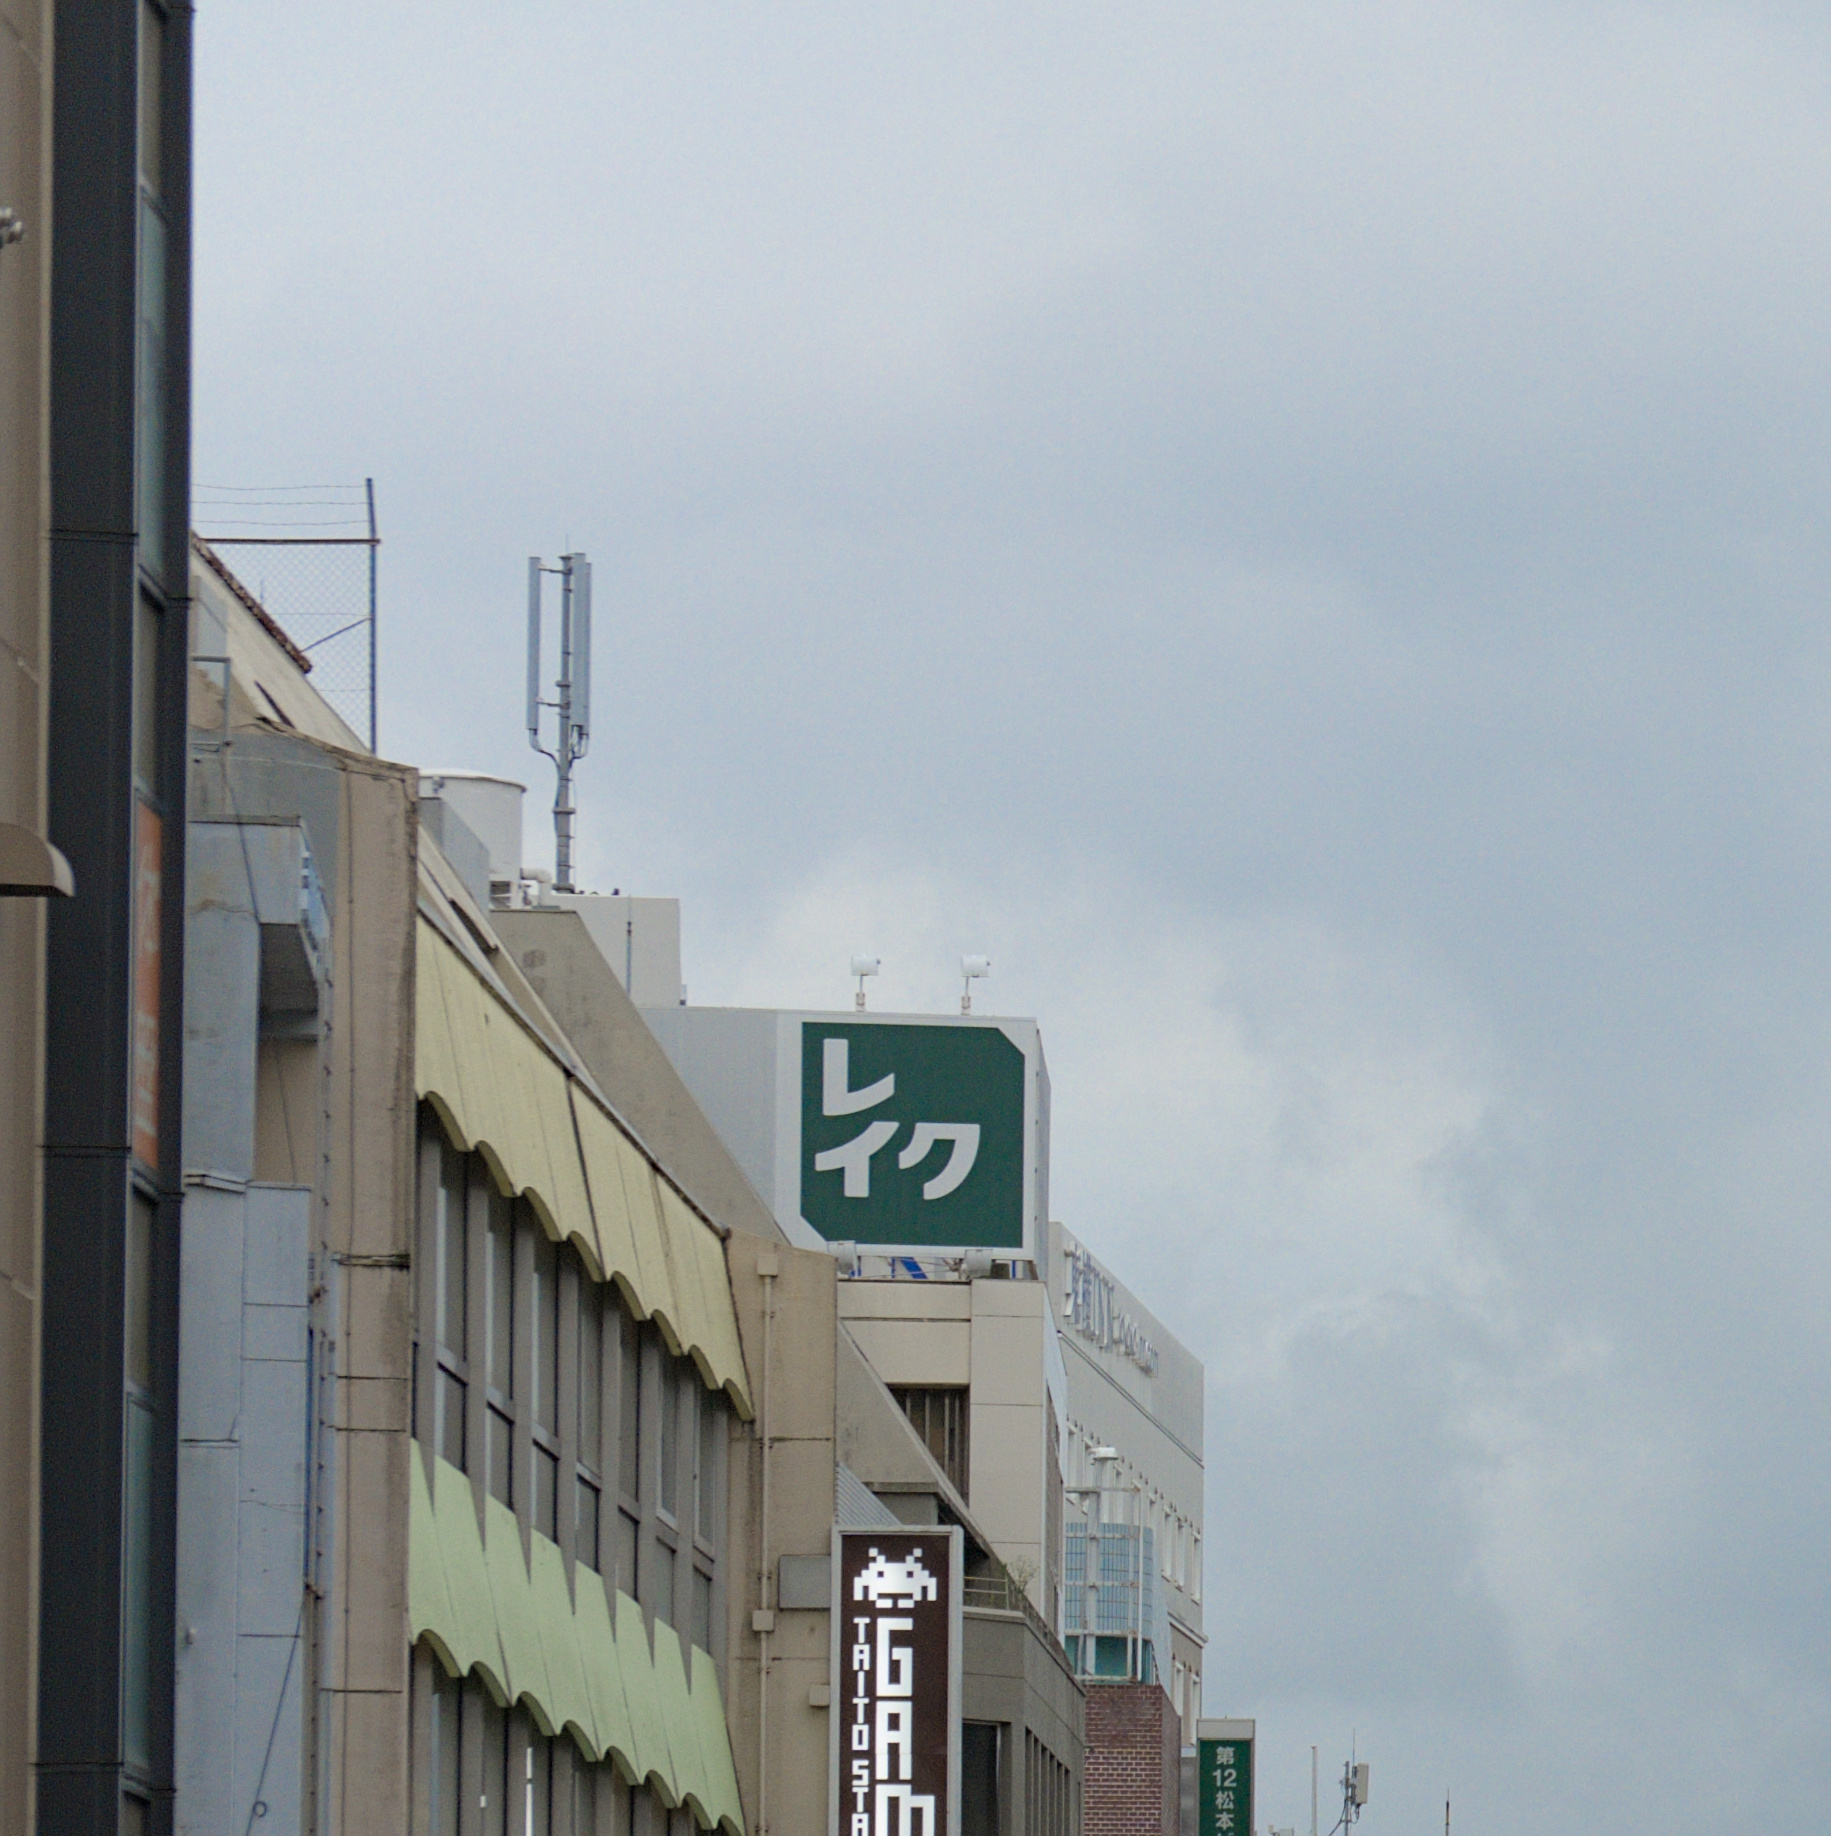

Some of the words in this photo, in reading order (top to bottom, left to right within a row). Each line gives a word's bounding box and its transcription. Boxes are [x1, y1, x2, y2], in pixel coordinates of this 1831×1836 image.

[822, 1038, 895, 1116] レ
[815, 1121, 981, 1200] イク
[851, 1616, 870, 1752] TAITO
